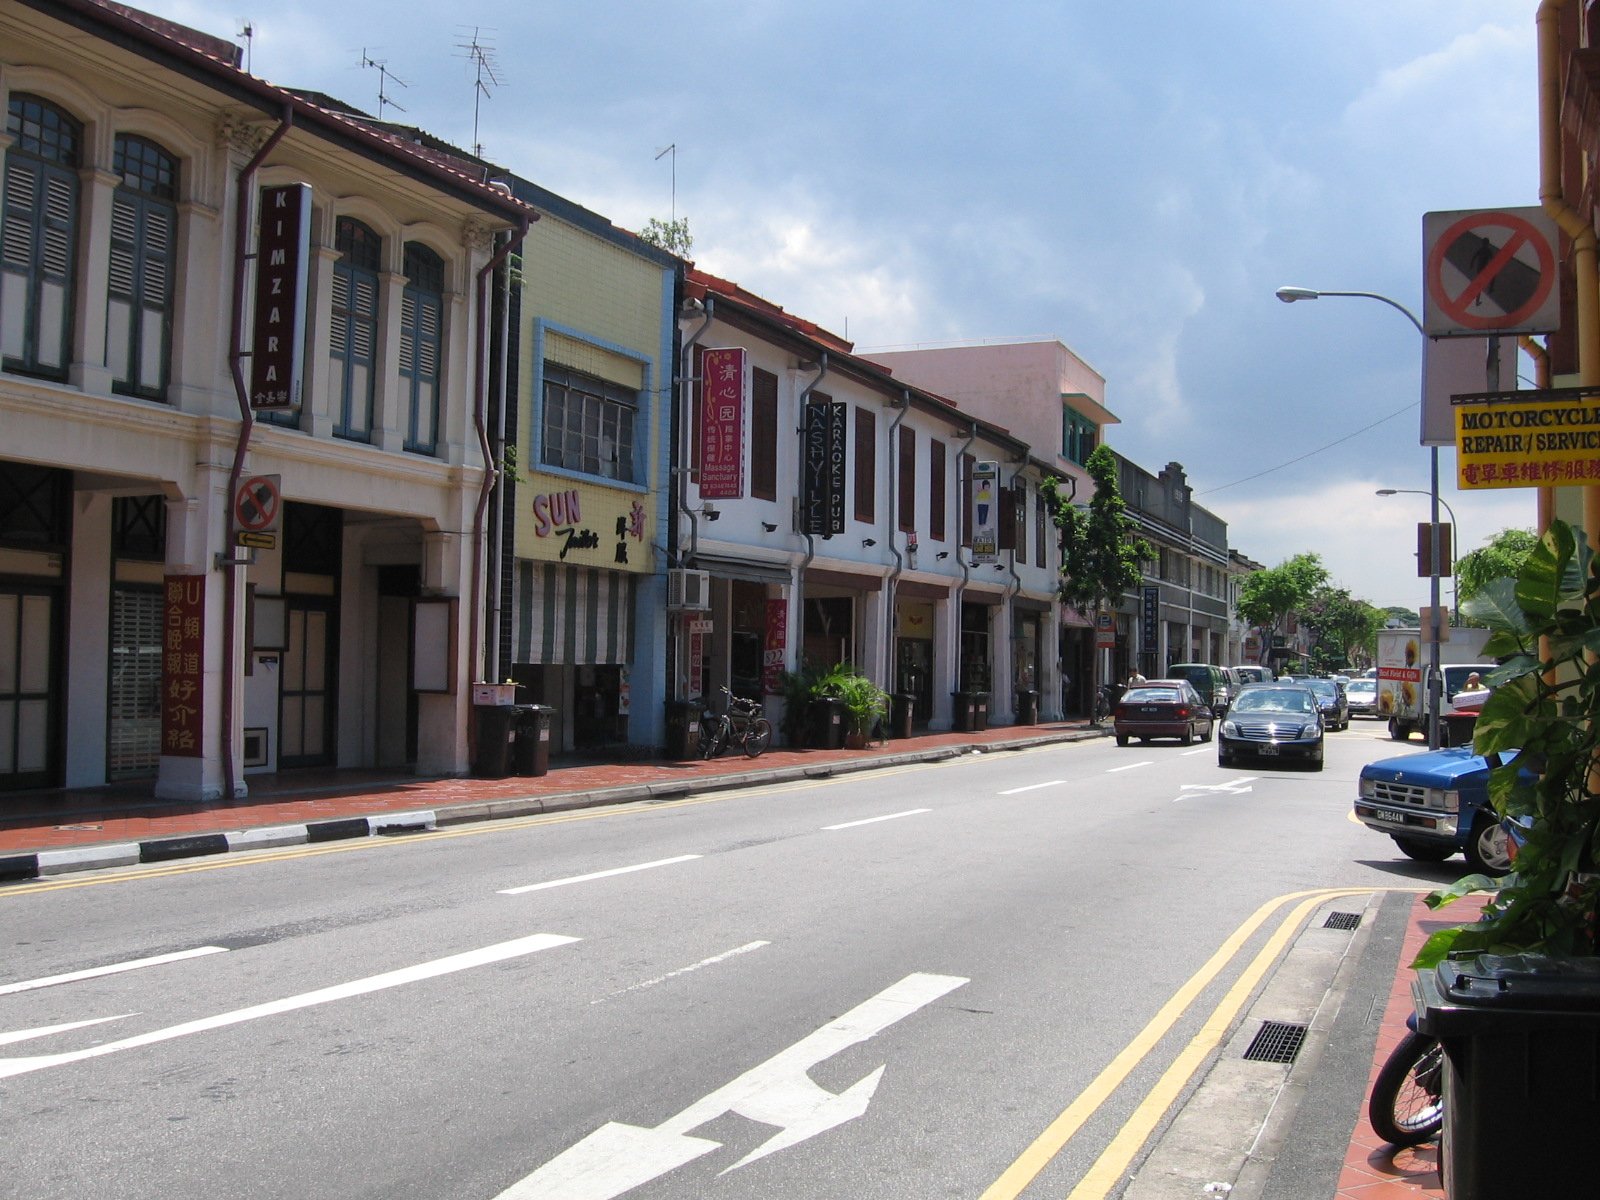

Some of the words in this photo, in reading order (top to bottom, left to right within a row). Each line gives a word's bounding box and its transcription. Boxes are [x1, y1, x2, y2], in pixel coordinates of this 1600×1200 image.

[265, 191, 287, 382] KIMZARA
[719, 364, 737, 422] 清心园
[831, 405, 842, 488] KARAOKE
[1536, 431, 1600, 451] SERVIC
[702, 473, 738, 482] Sanctuary
[704, 464, 735, 473] Massage
[532, 489, 581, 538] SUN
[831, 494, 841, 531] PUB
[555, 528, 599, 560] Tailor
[167, 581, 183, 675] 聯合晚報
[167, 679, 197, 749] 好介紹
